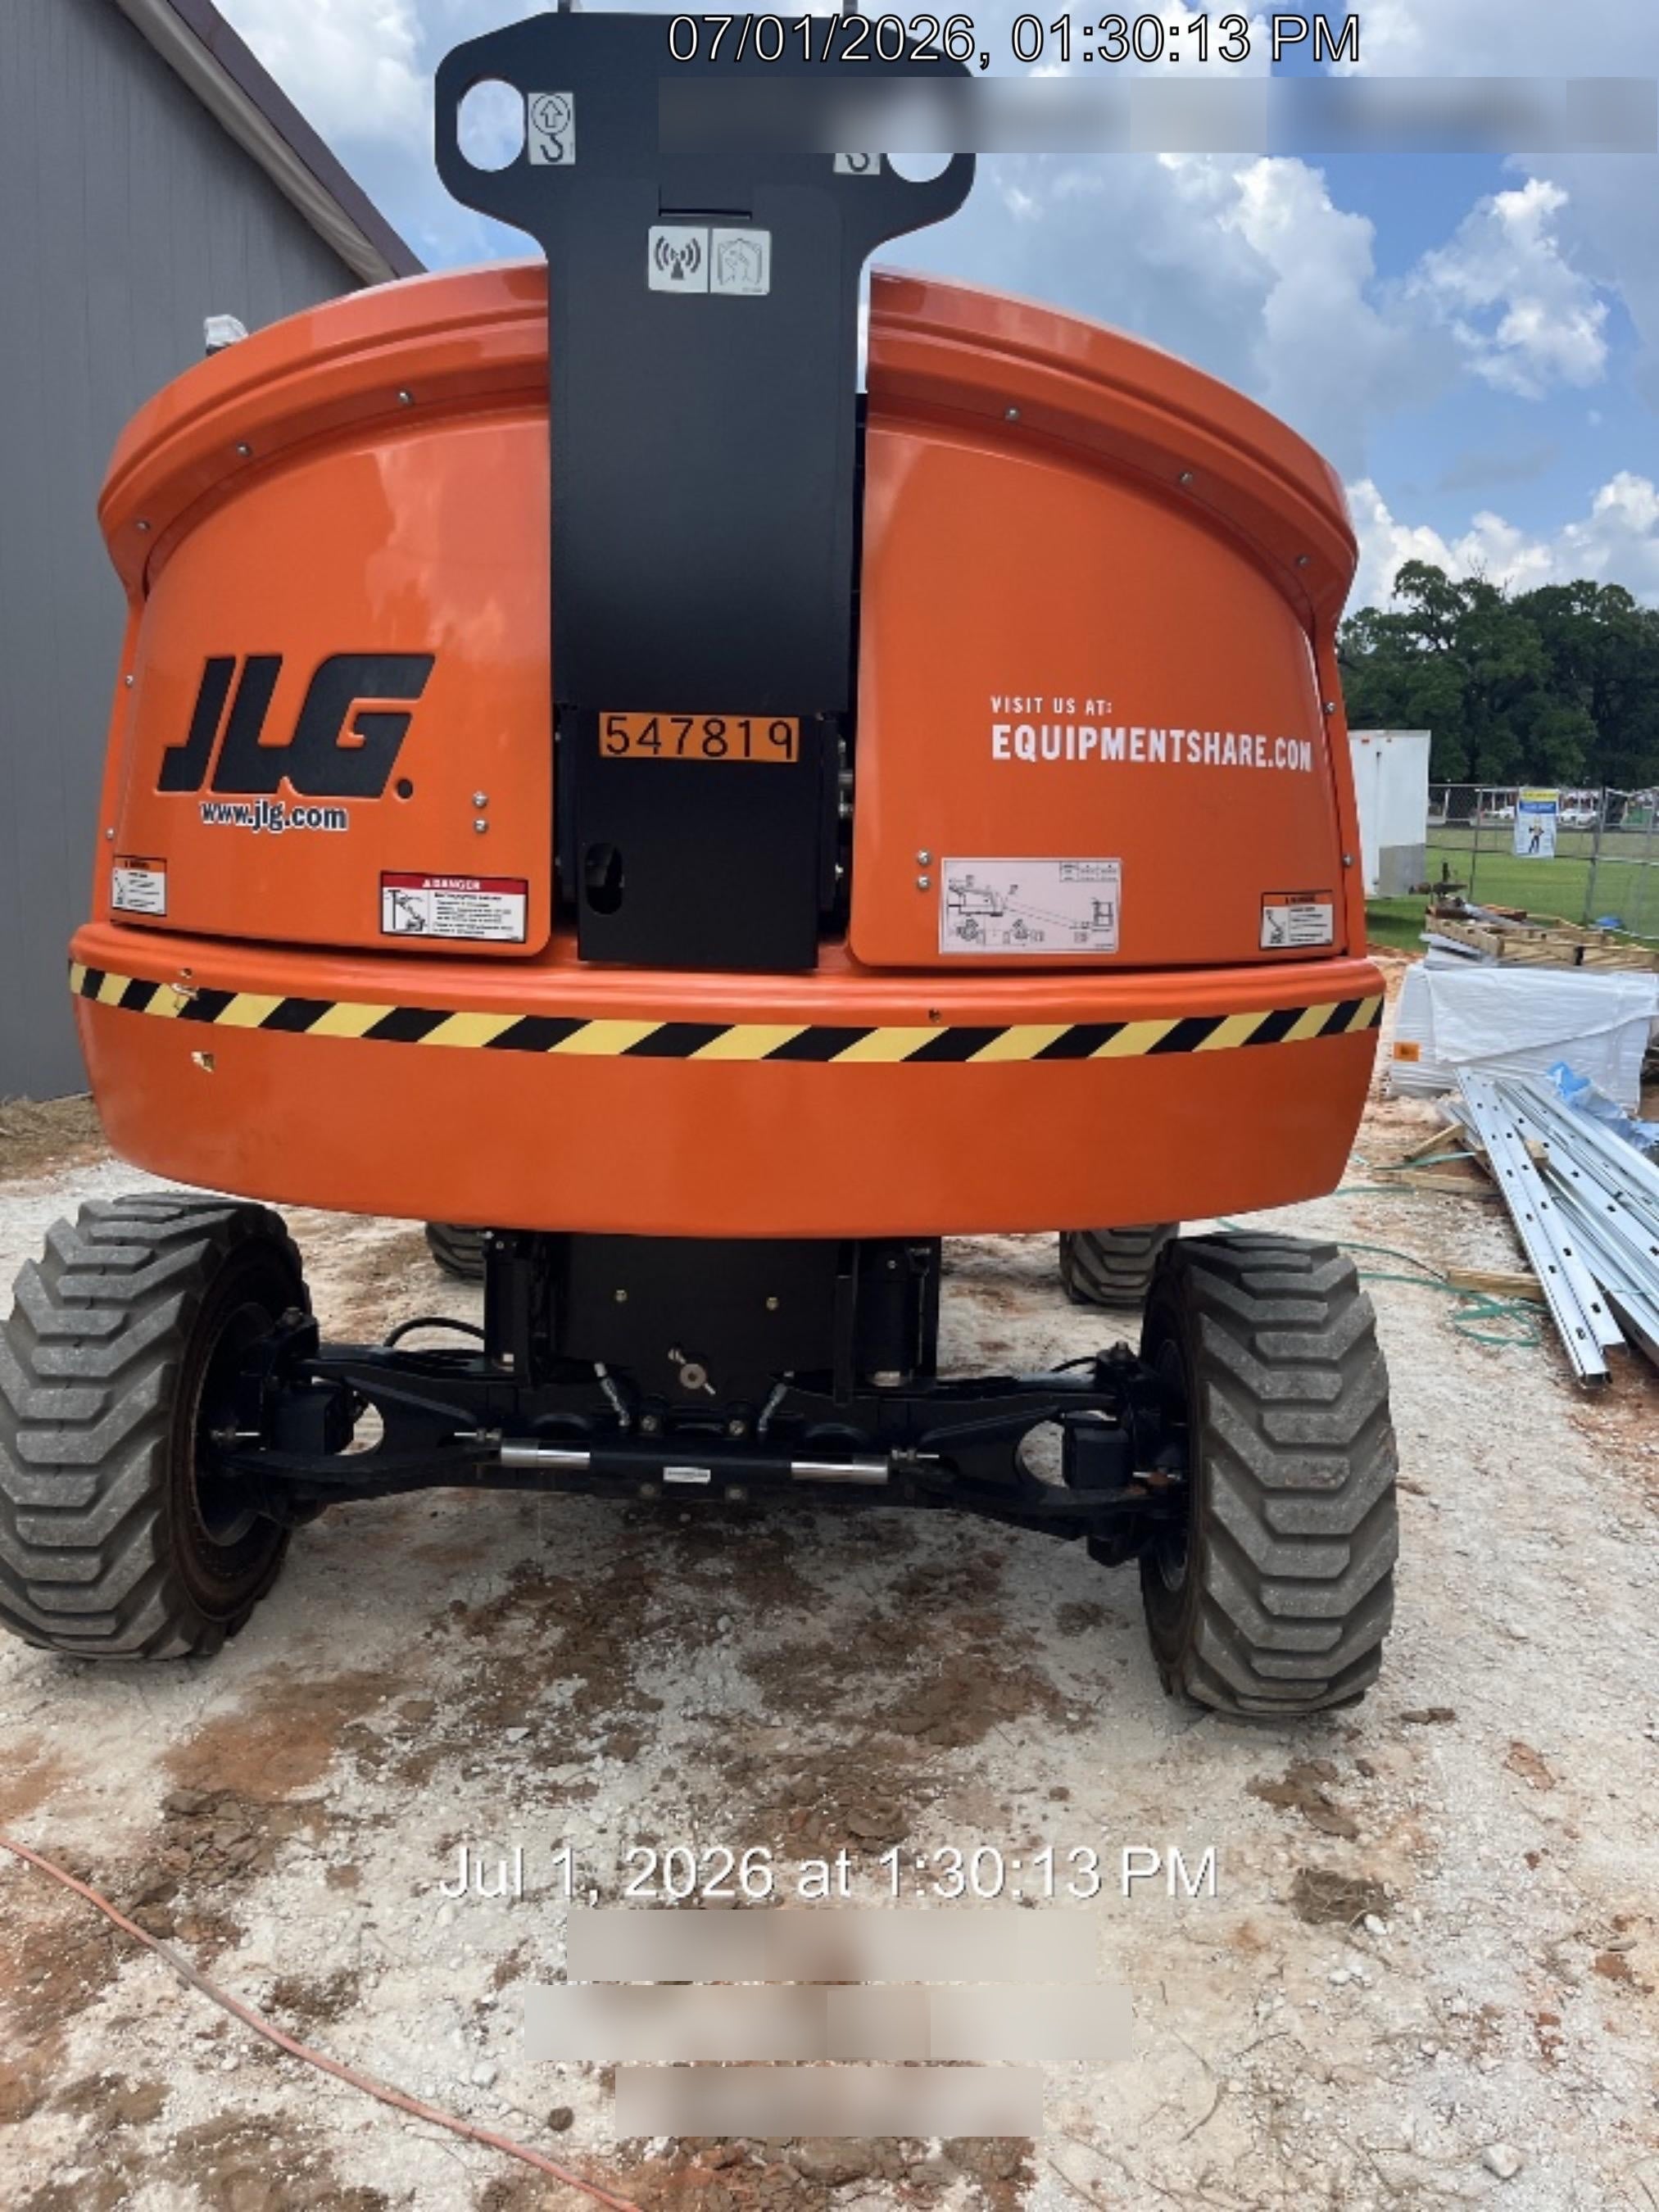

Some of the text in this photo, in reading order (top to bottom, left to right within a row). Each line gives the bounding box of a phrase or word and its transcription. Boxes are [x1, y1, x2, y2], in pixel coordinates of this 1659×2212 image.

[990, 695, 1113, 716] VISIT US AT:
[605, 714, 793, 760] 547819
[201, 799, 348, 832] www.jlg.com
